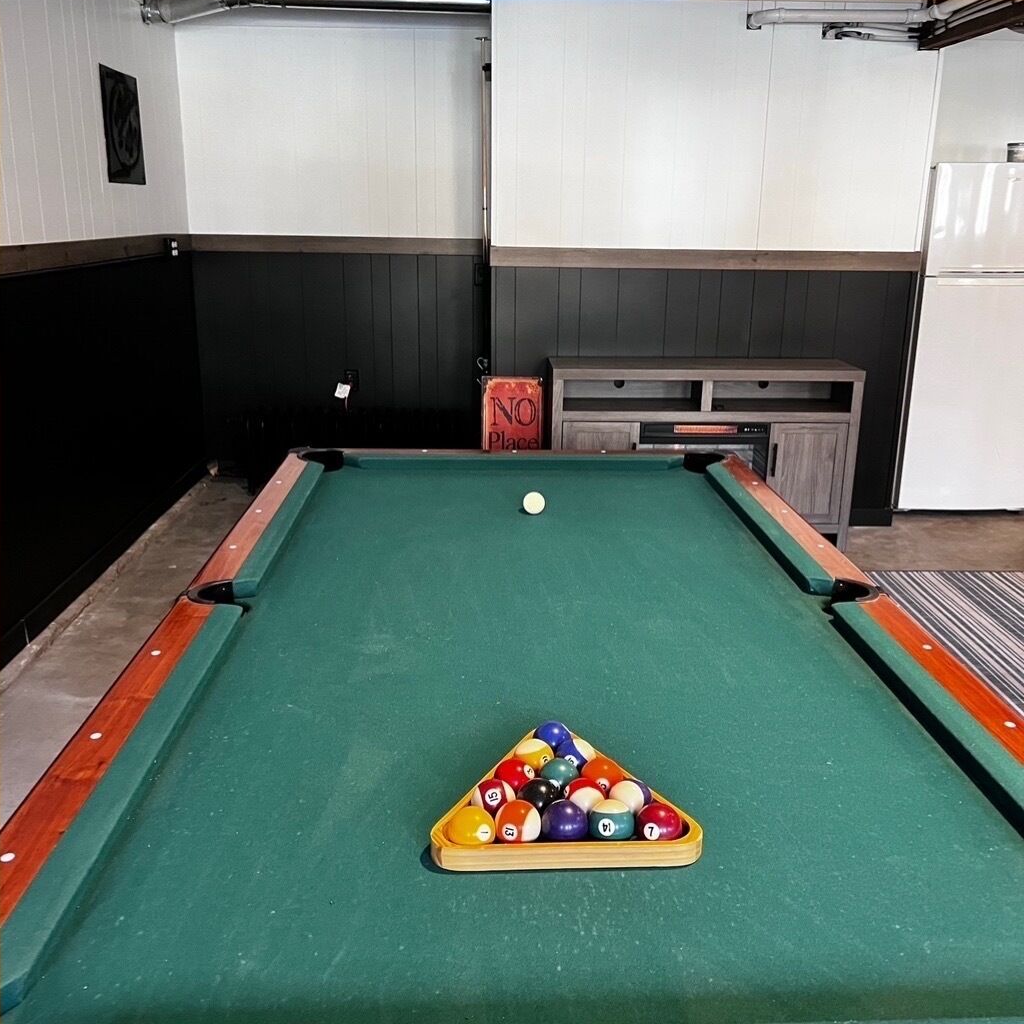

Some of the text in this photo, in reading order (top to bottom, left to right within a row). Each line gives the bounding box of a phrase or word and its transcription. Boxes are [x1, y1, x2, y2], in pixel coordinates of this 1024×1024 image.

[489, 396, 537, 427] NO
[488, 431, 540, 450] Place
[487, 791, 499, 802] 15
[504, 827, 515, 837] 13
[602, 822, 612, 833] 14
[647, 826, 655, 837] 7
